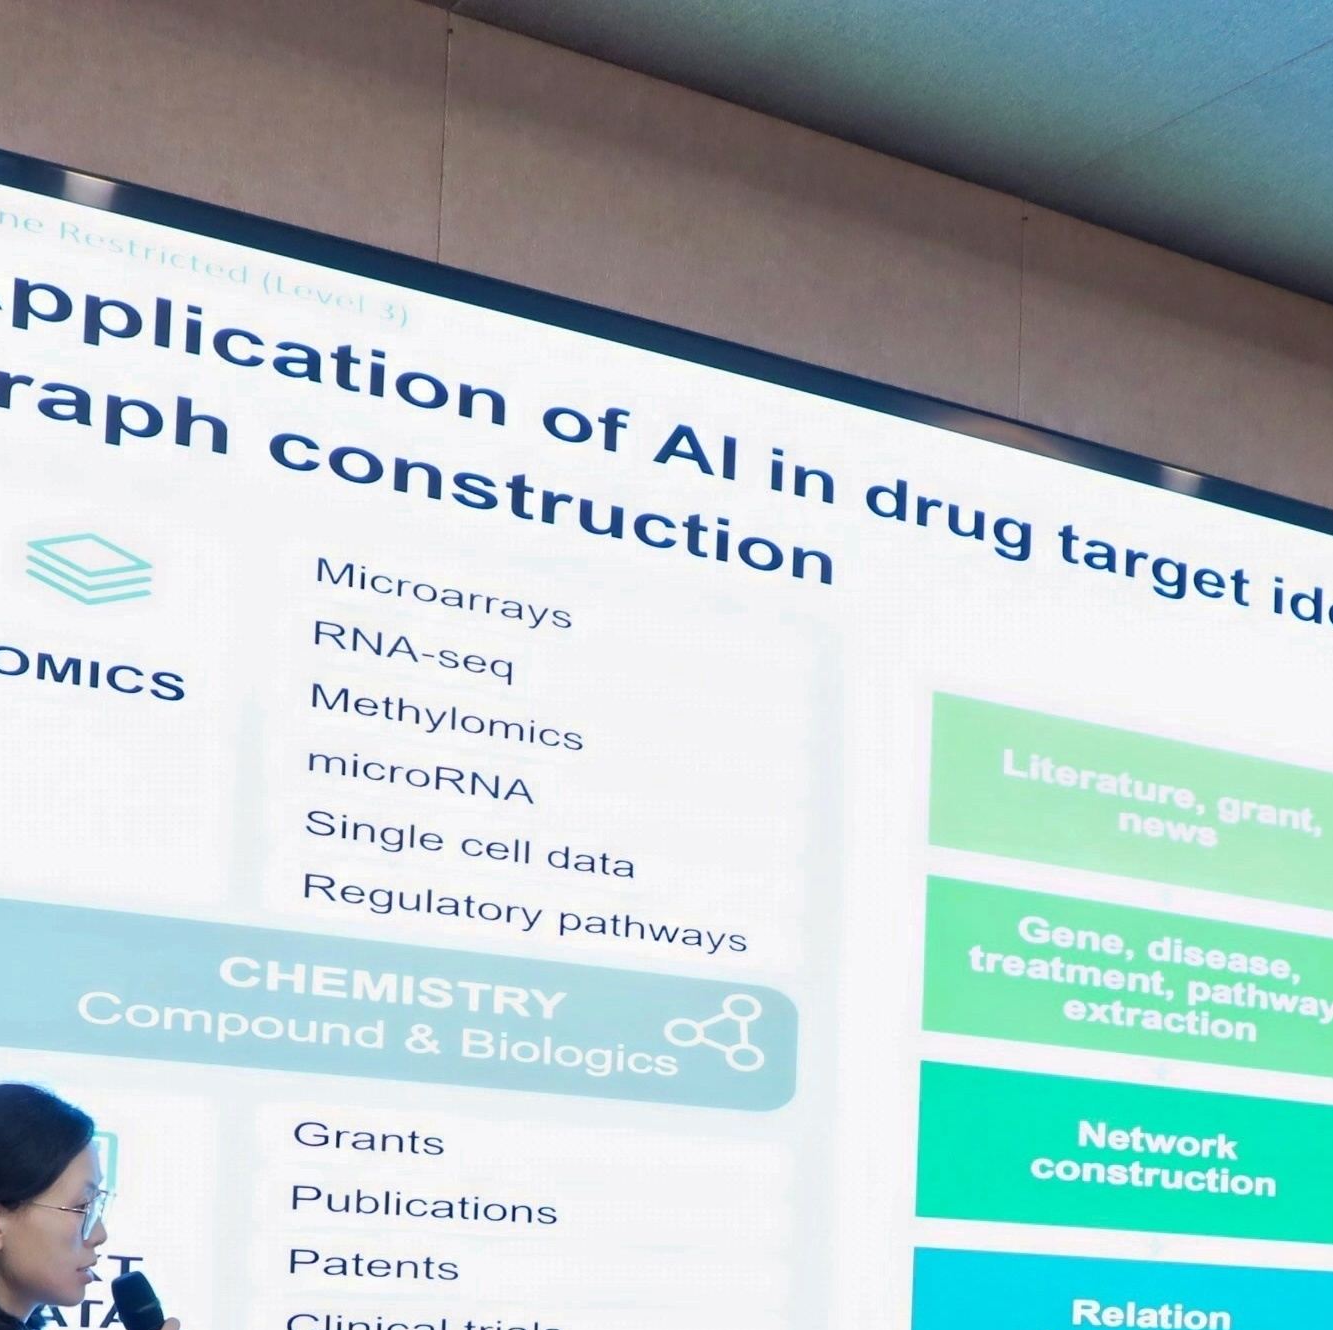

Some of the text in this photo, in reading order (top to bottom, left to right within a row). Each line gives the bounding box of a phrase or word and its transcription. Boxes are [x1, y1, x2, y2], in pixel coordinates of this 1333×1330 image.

[59, 221, 250, 285] Restricted
[260, 268, 367, 316] (Level
[381, 299, 412, 331] 3)
[269, 432, 833, 586] construction
[542, 406, 630, 453] of
[653, 424, 737, 481] AI
[770, 447, 834, 505] in
[865, 479, 1032, 562] drug
[1057, 524, 1250, 607] target
[316, 557, 572, 630] Microarrays
[314, 620, 513, 686] RNA-seq
[311, 683, 583, 751] Methylomics
[309, 753, 534, 805] microRNA
[1002, 748, 1322, 838] Literature, grant,
[305, 810, 634, 879] Single cell data
[1118, 811, 1219, 849] news
[304, 873, 747, 955] Regulatory pathways
[968, 944, 1175, 1002] treatment,
[1017, 915, 1301, 985] Gene, disease,
[219, 955, 567, 1020] CHEMISTRY
[77, 990, 680, 1078] Compound & Biologics
[1062, 998, 1258, 1043] extraction
[293, 1121, 444, 1156] Grants
[1077, 1119, 1238, 1161] Network
[291, 1184, 558, 1225] Publications
[1029, 1157, 1277, 1197] construction
[290, 1248, 459, 1281] Patents
[1071, 1298, 1232, 1330] Relation
